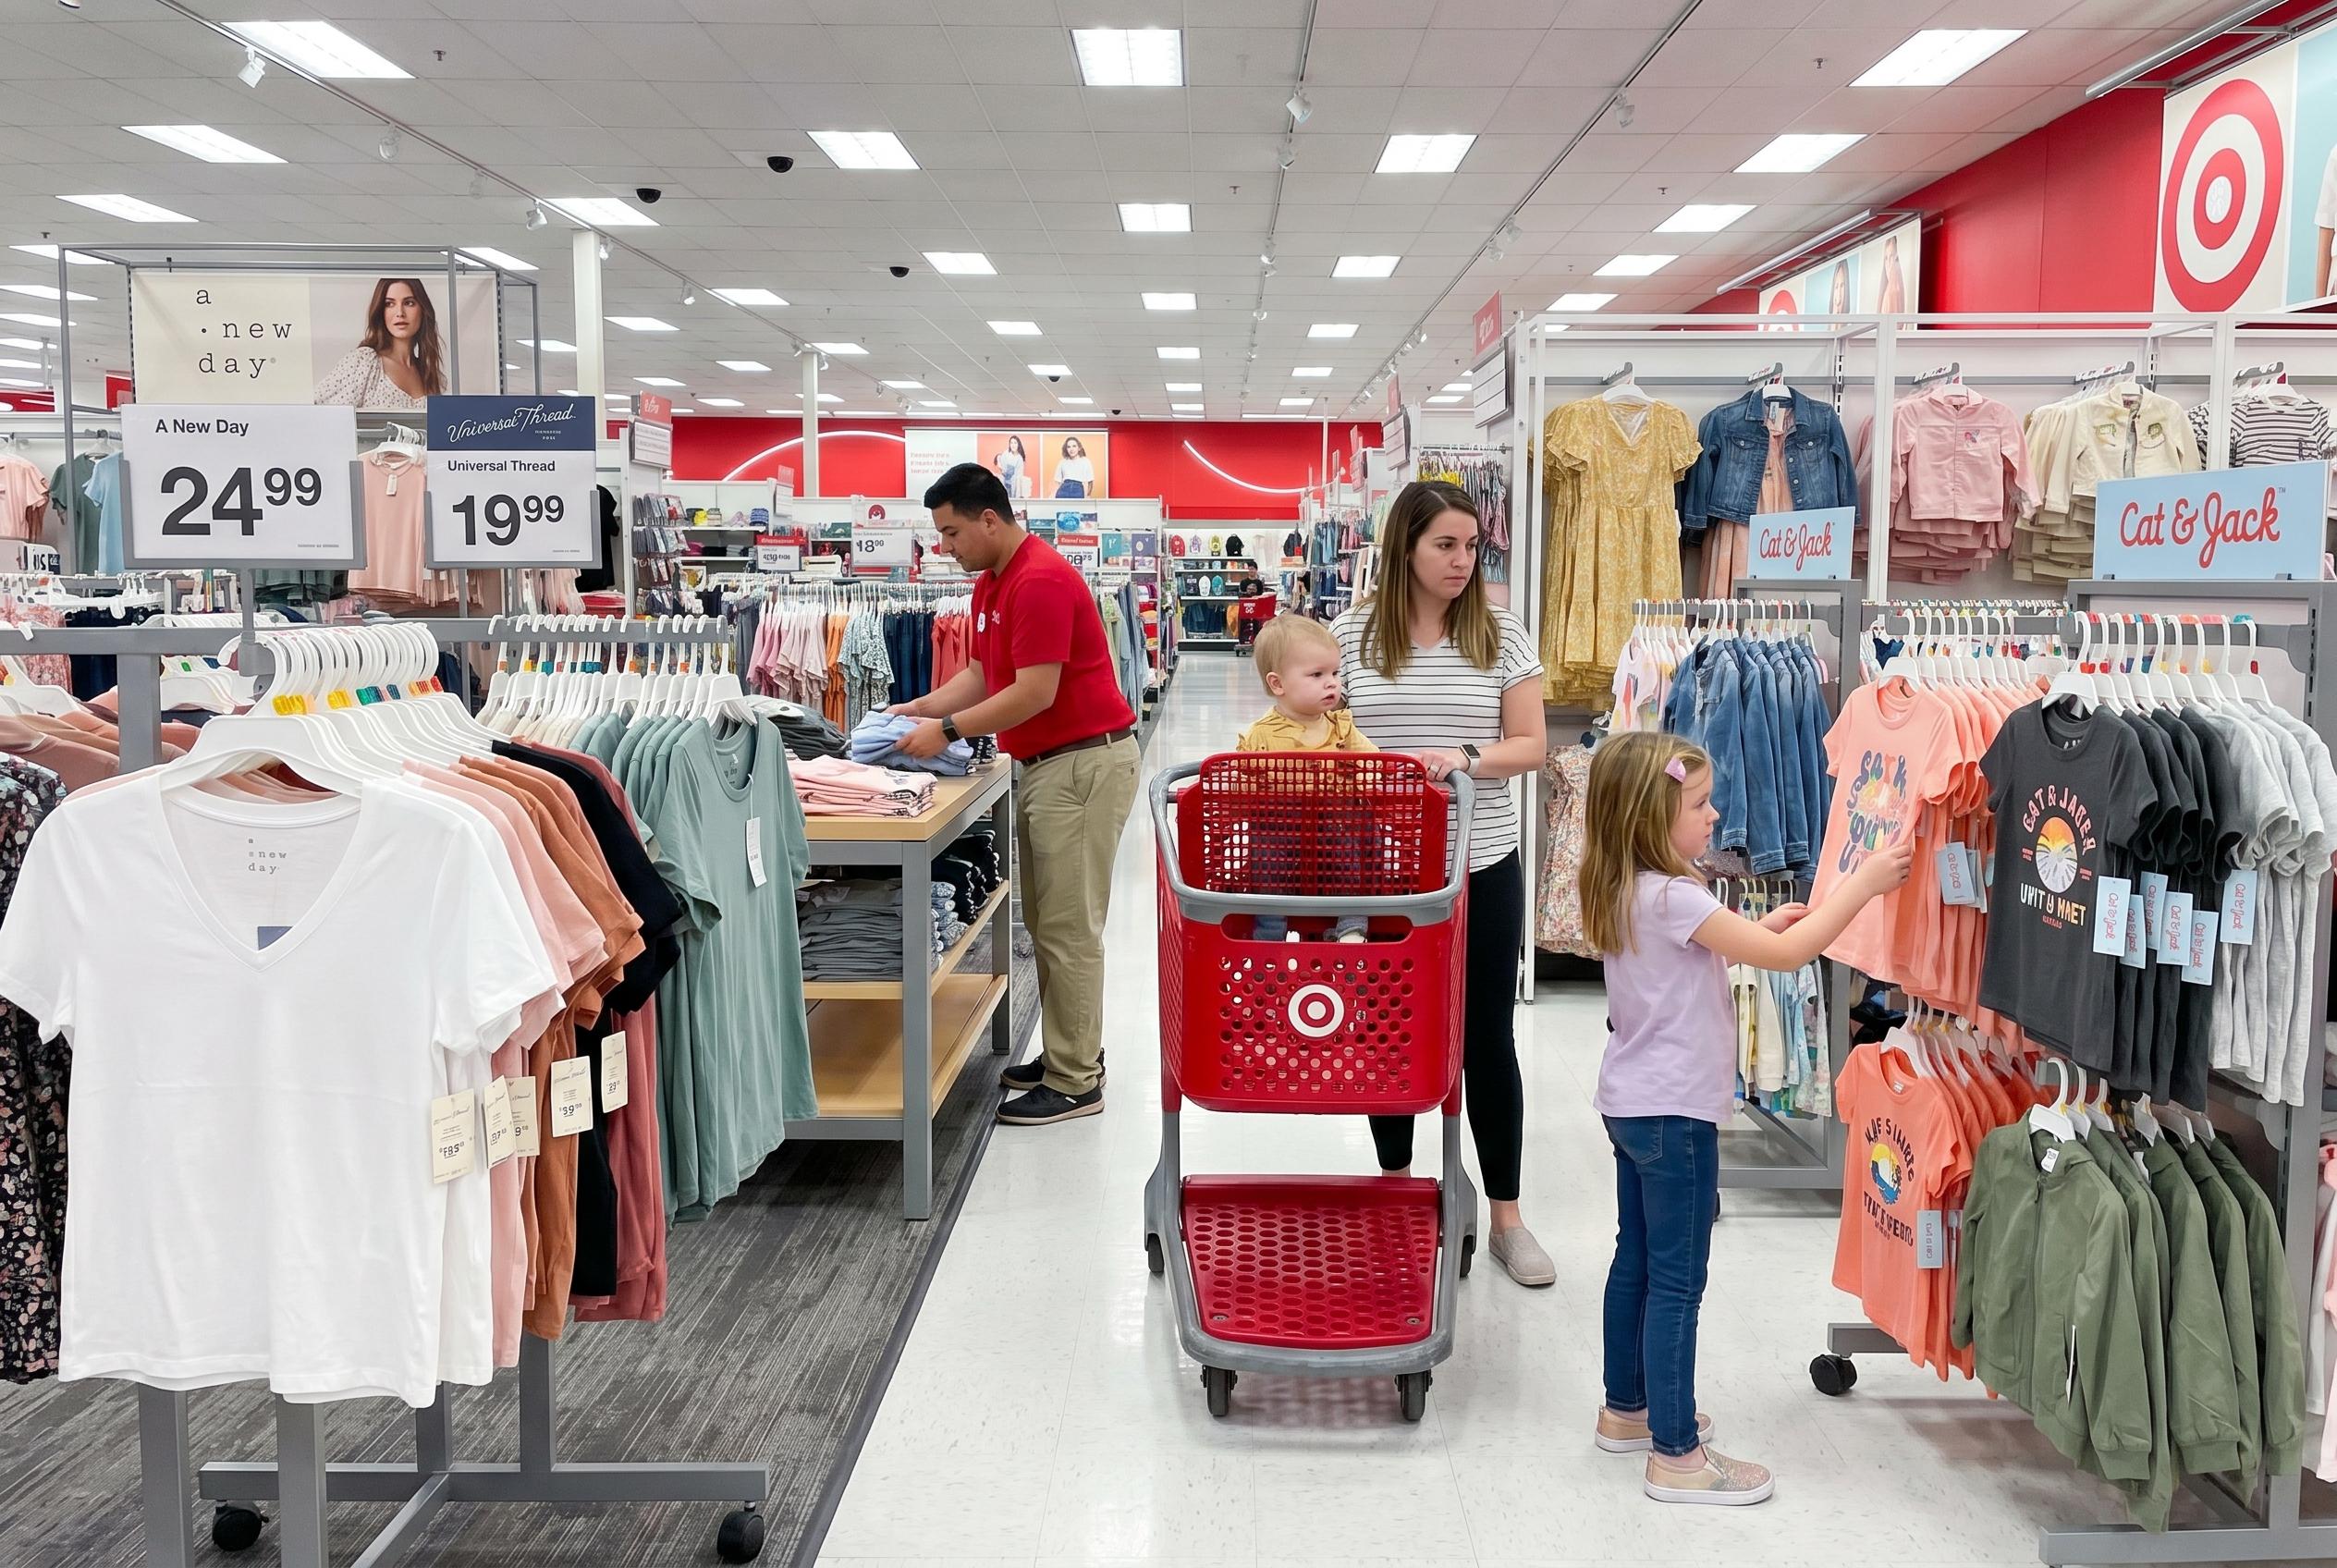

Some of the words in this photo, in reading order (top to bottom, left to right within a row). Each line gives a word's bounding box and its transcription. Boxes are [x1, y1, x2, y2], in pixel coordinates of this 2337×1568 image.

[196, 288, 212, 305] a
[155, 419, 168, 433] A
[173, 419, 211, 434] New
[216, 419, 250, 436] Day
[447, 415, 520, 443] Universal
[514, 403, 575, 433] Thread
[447, 460, 508, 472] Universal
[510, 460, 556, 472] Thread
[2120, 502, 2165, 547] Cat
[2172, 497, 2199, 545] &
[2198, 486, 2281, 569] Jack
[1759, 528, 1782, 558] Cat
[1783, 527, 1797, 557] &
[1795, 521, 1832, 571] Jack
